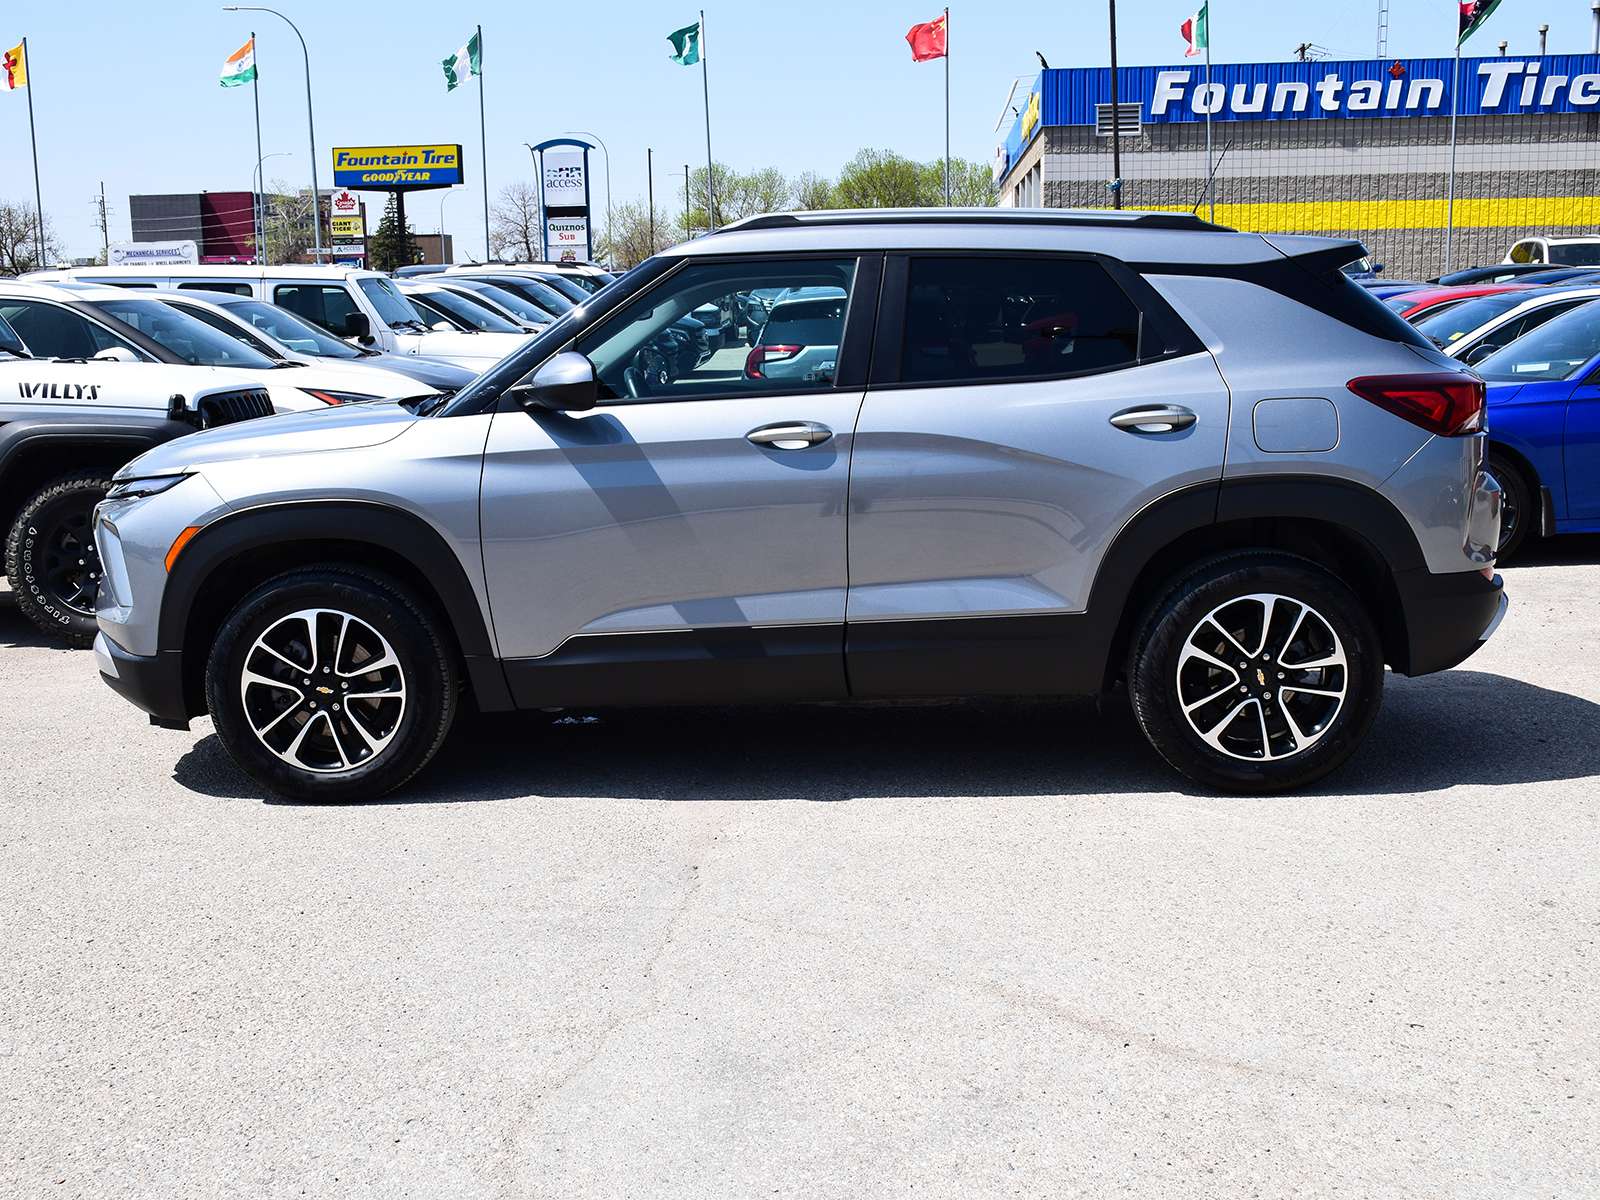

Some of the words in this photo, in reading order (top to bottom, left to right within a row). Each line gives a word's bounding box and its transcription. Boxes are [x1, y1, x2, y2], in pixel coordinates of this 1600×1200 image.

[1150, 69, 1444, 115] Fountain
[1477, 61, 1600, 108] Tire
[336, 152, 418, 167] Fountain
[421, 150, 455, 164] Tire
[362, 171, 431, 183] GOODYEAR
[546, 178, 583, 189] access
[548, 223, 585, 231] Quiznos
[155, 248, 178, 256] SERVICES
[18, 382, 101, 400] WILLYS
